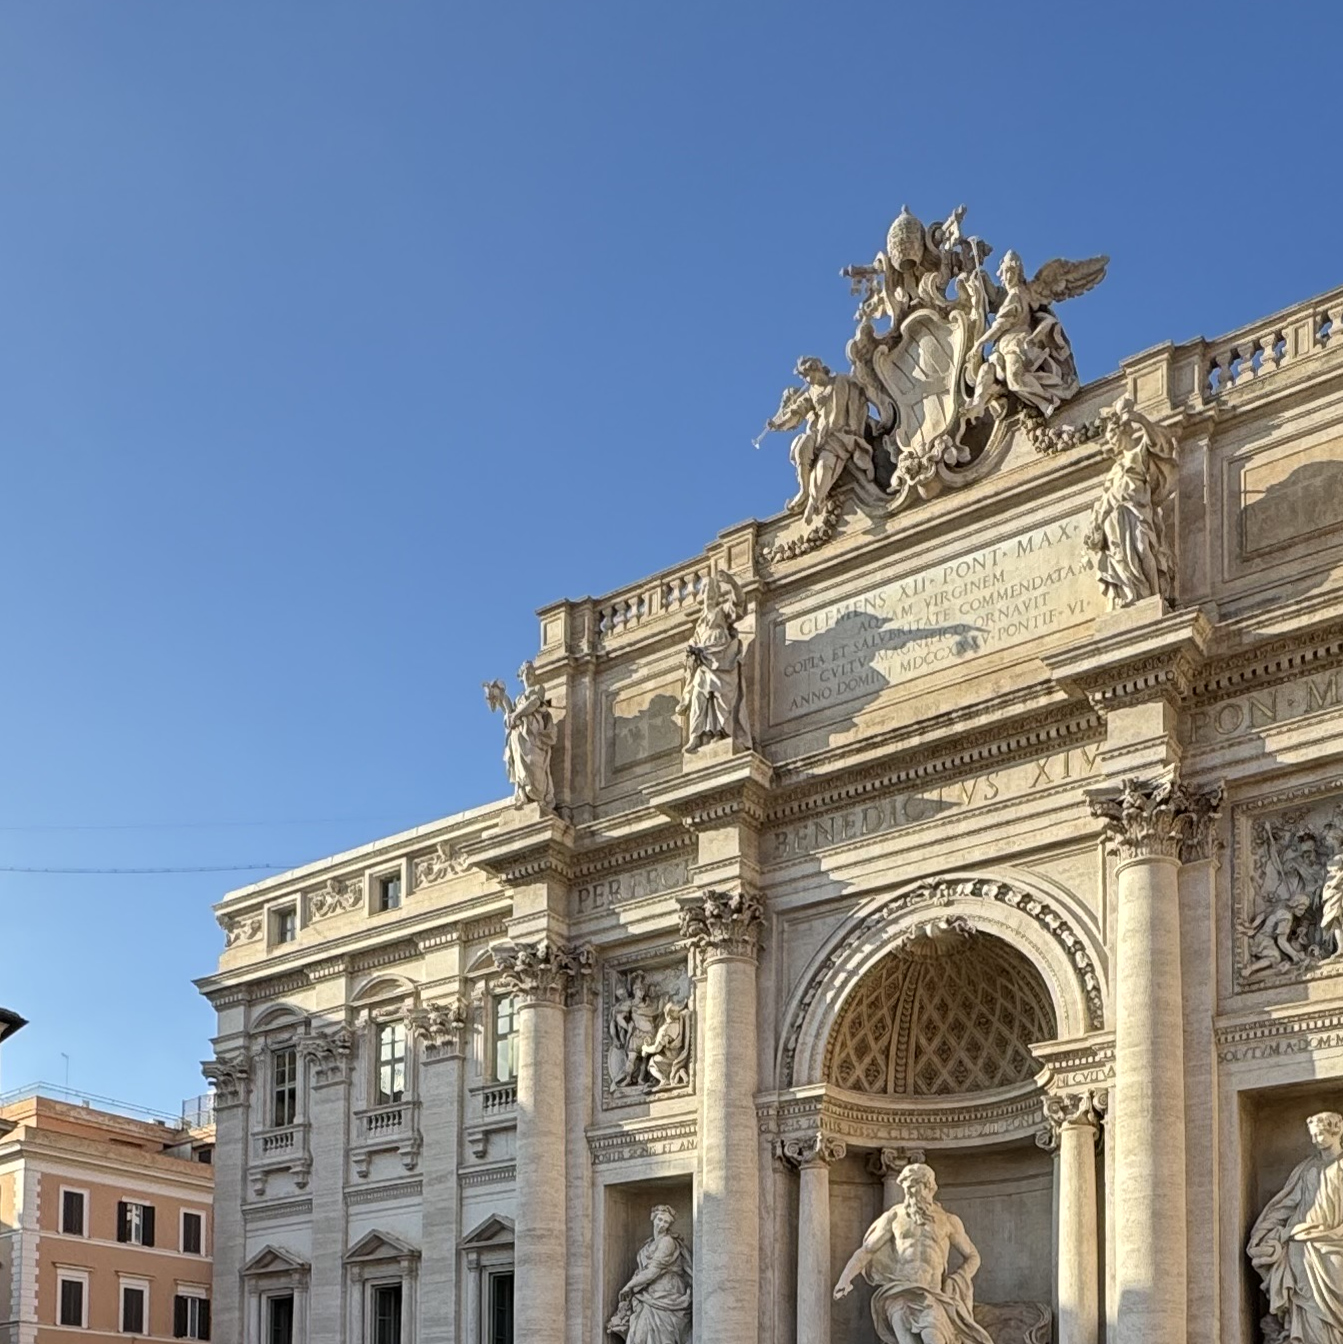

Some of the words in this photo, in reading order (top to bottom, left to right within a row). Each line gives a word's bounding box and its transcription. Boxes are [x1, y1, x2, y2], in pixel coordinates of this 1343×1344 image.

[924, 568, 1006, 609] VIRGINEM
[799, 590, 887, 637] CLEMENS
[973, 592, 1051, 627] ORNAVIT
[783, 654, 826, 678] COPIA
[831, 642, 851, 663] ET
[789, 686, 832, 712] ANNO
[773, 772, 1000, 856] BENEDICTVS
